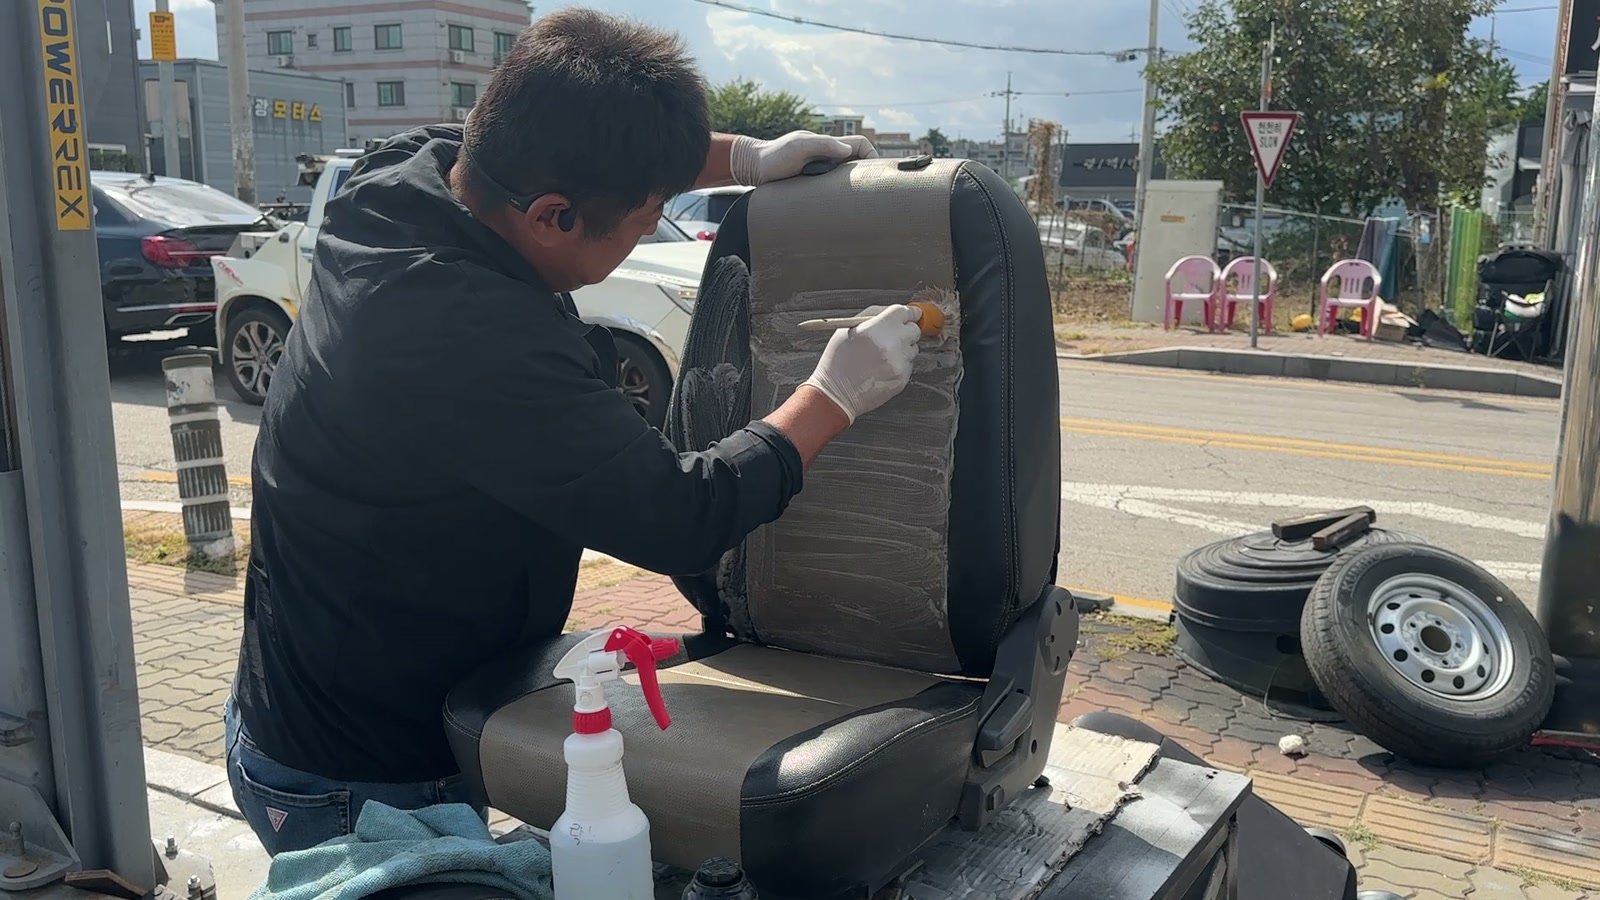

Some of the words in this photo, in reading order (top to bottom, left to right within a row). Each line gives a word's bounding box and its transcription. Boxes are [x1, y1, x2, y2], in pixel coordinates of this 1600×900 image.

[42, 0, 85, 218] OWERREX
[1258, 121, 1282, 135] 천천히
[1259, 135, 1279, 149] SLOW
[1341, 552, 1383, 592] KUMHO
